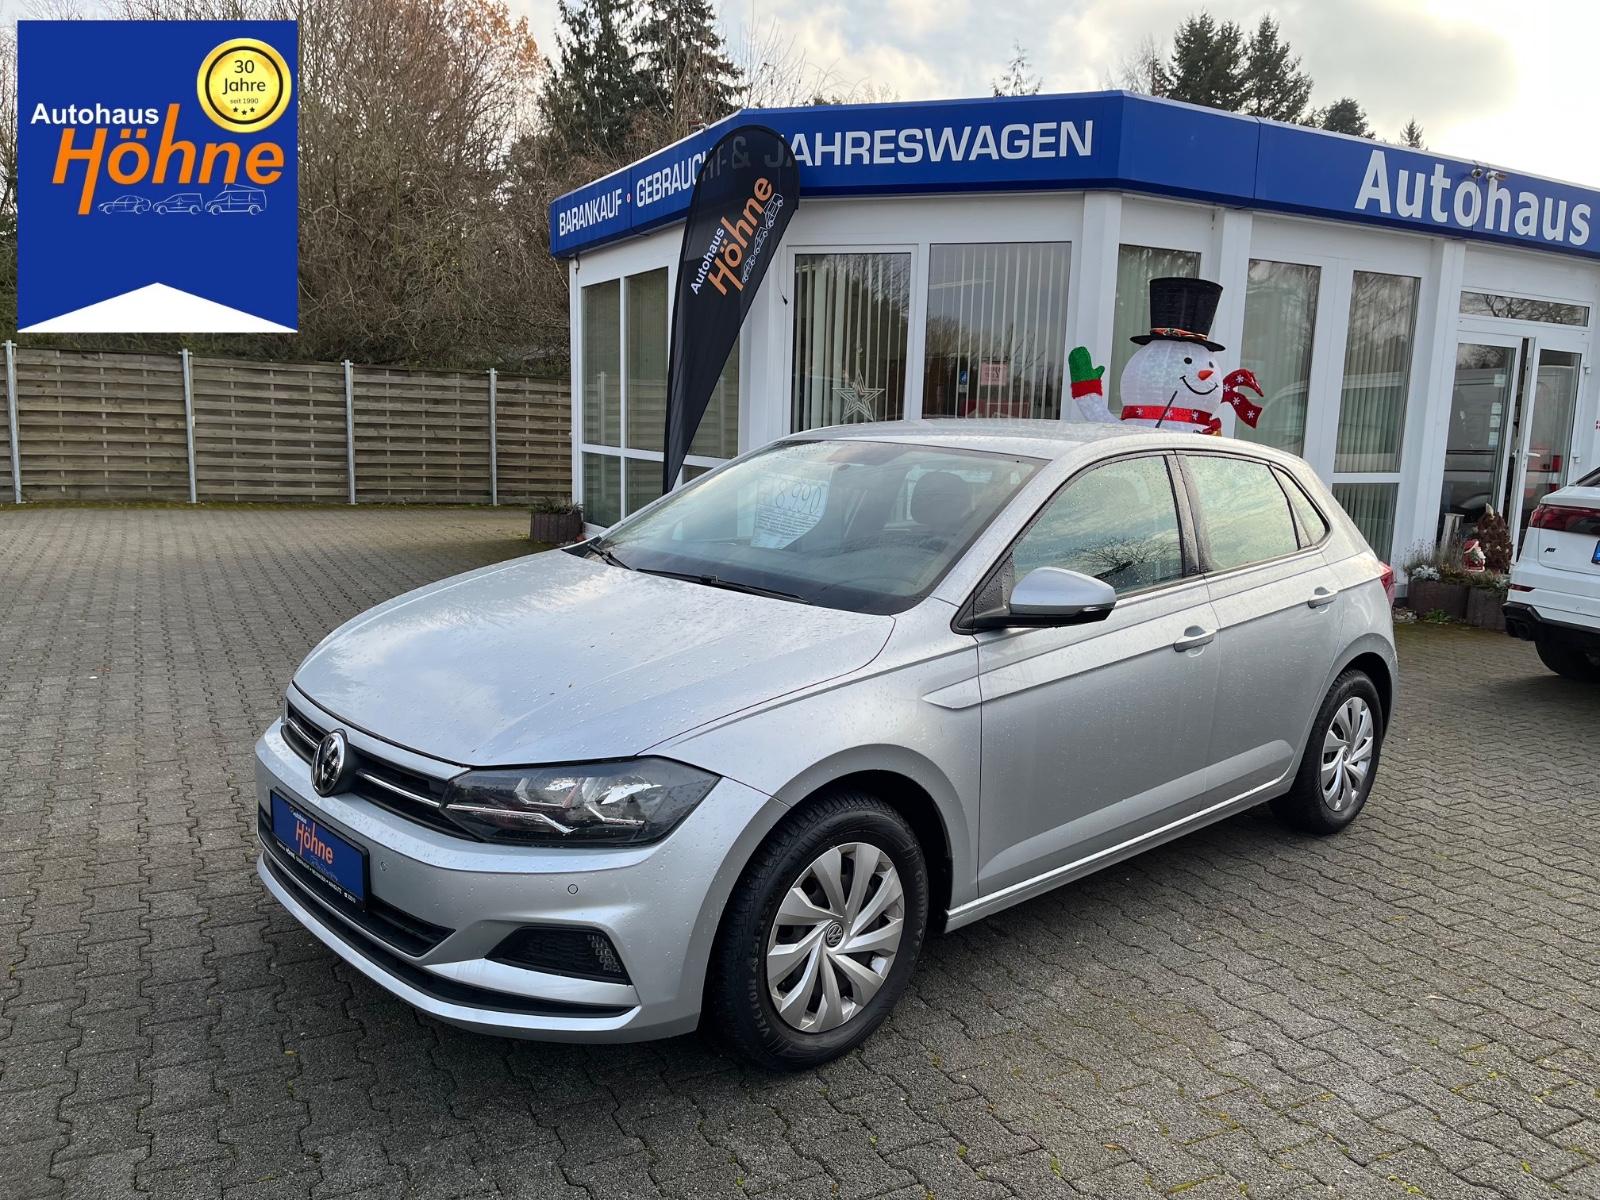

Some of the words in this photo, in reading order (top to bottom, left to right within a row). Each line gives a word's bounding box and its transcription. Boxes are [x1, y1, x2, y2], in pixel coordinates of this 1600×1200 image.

[559, 188, 623, 237] BARANKAUF
[1354, 149, 1592, 246] Autohaus
[690, 227, 725, 295] Autohaus
[707, 177, 773, 296] Höhne
[295, 820, 334, 865] Höhne
